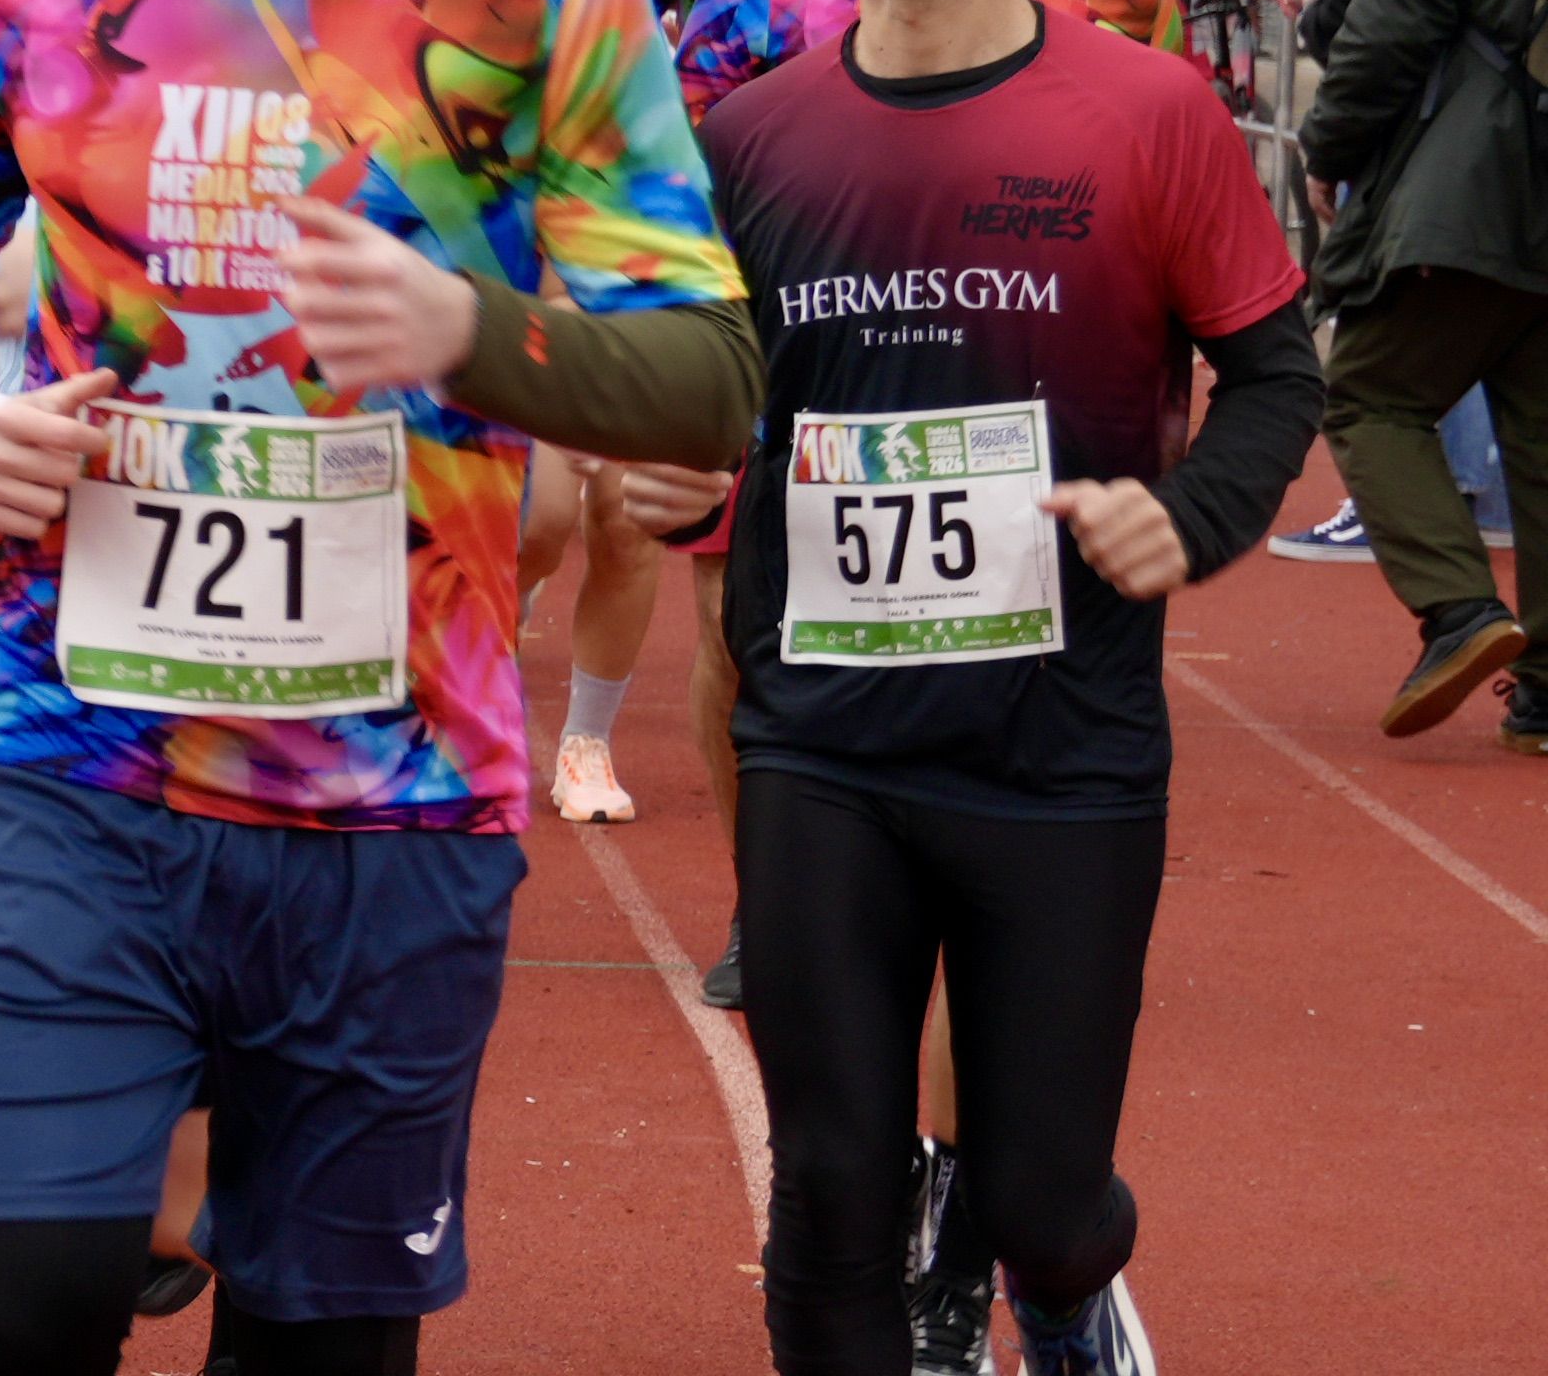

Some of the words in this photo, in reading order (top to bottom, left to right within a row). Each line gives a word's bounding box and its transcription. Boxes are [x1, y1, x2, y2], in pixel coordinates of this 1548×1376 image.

[152, 82, 254, 159] XII
[148, 156, 251, 210] MEDIA
[997, 173, 1069, 201] TRIBU
[147, 196, 301, 253] MARATÓN
[960, 202, 1095, 242] HERMES
[166, 245, 228, 288] 10K
[777, 268, 948, 327] HERMES
[953, 267, 1062, 314] GYM
[859, 324, 964, 347] Training
[106, 414, 192, 492] 10K
[798, 422, 867, 484] 10K
[135, 501, 306, 623] 721
[834, 490, 978, 587] 575
